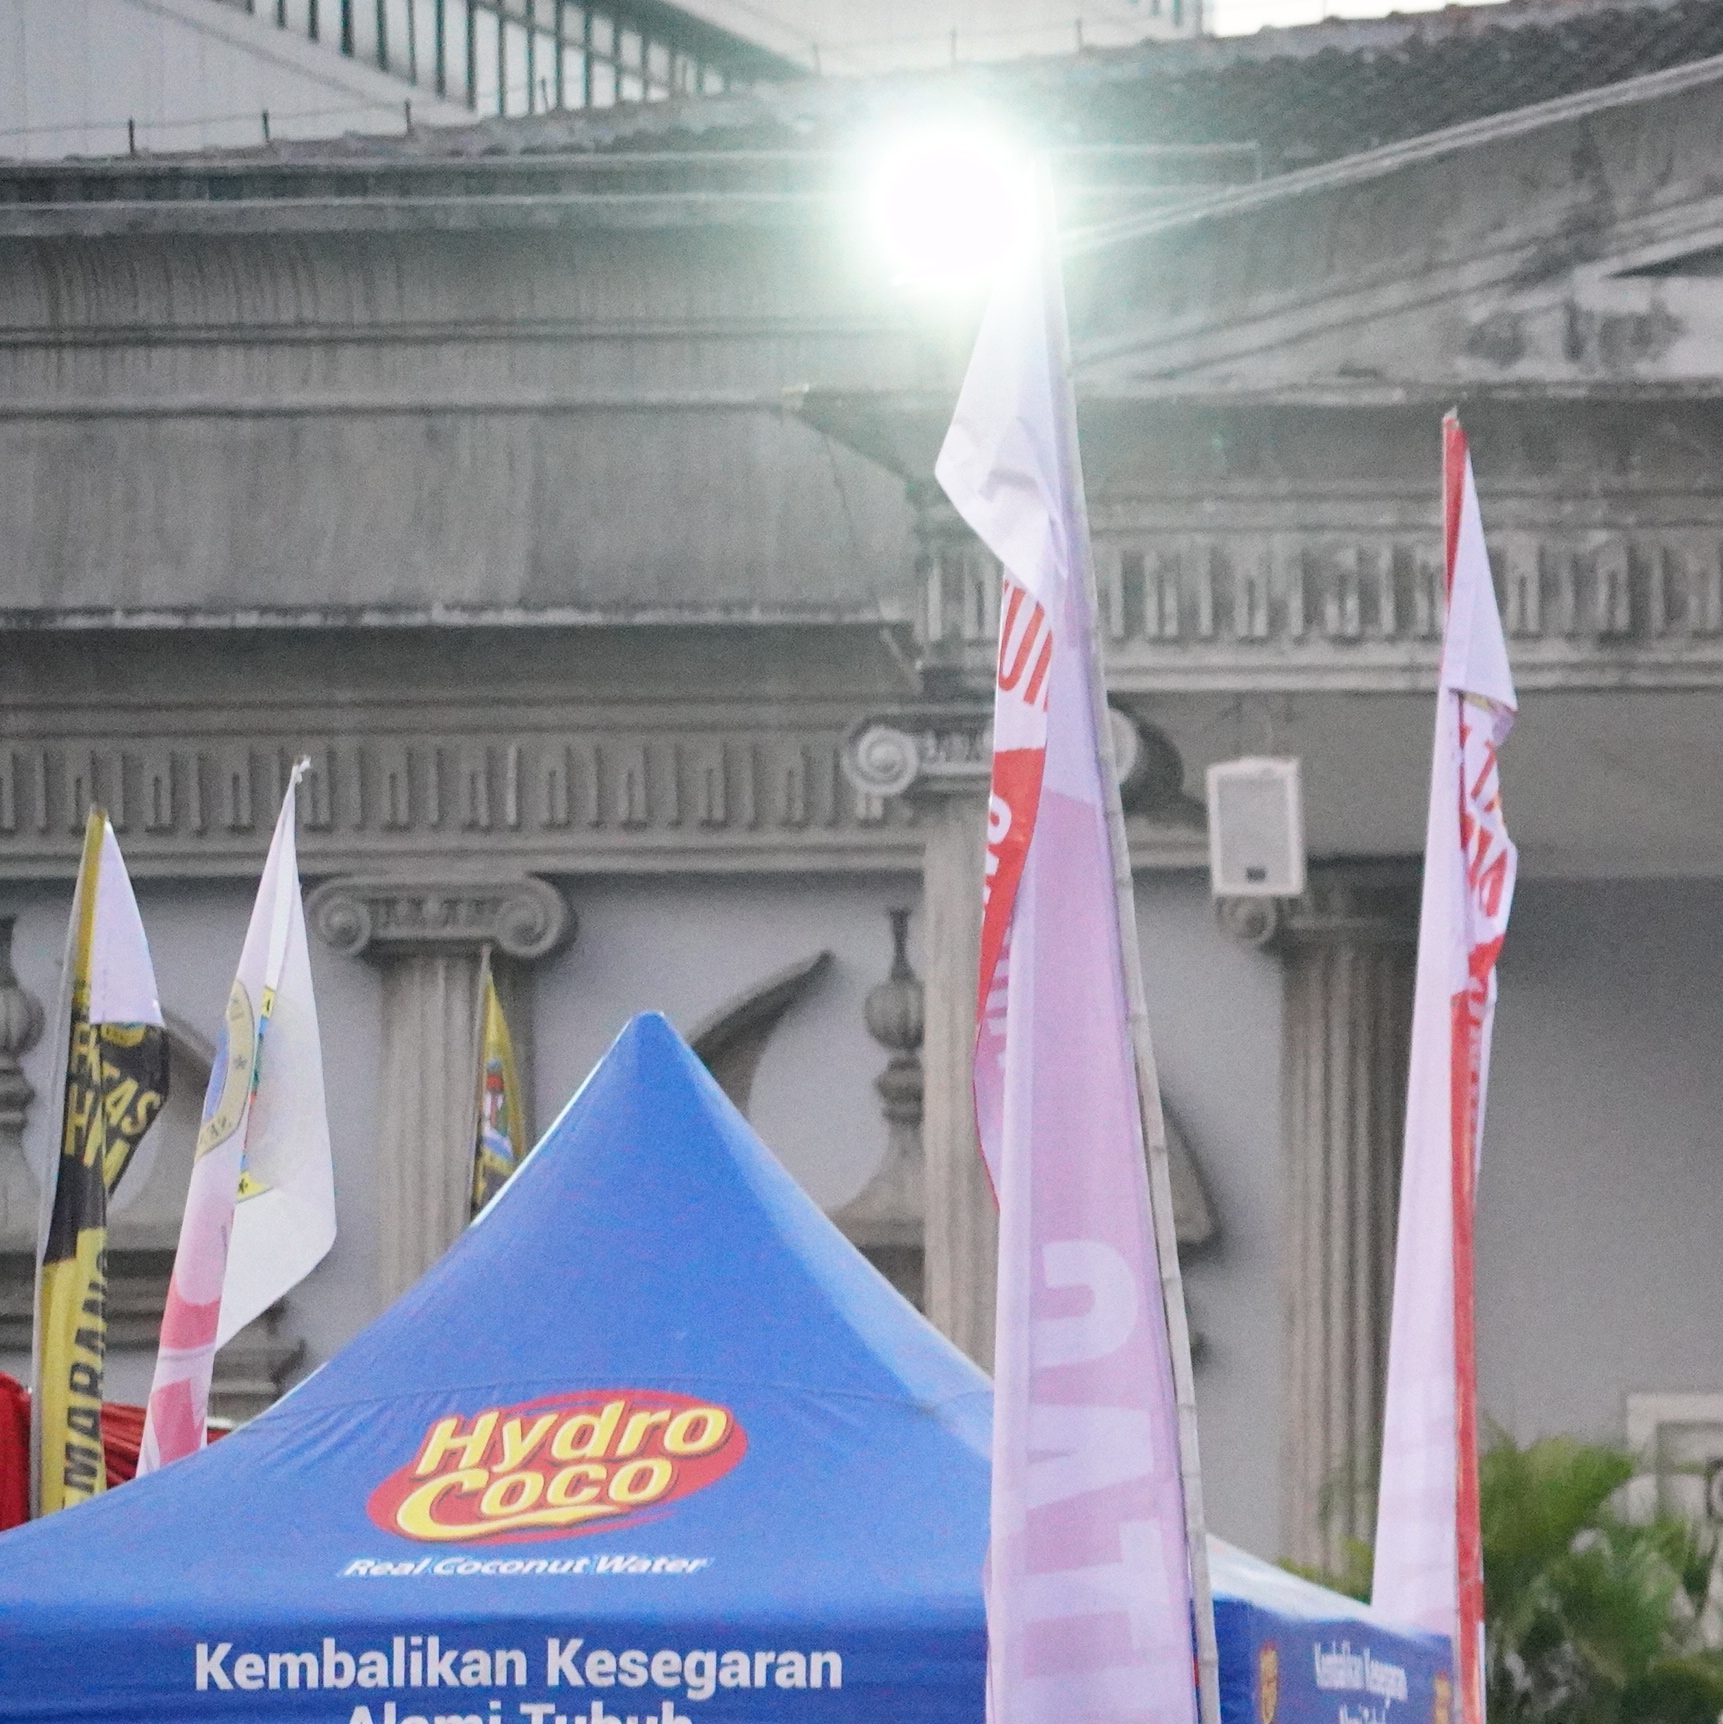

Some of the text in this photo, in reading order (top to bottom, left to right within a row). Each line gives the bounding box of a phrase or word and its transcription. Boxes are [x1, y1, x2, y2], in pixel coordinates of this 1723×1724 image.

[414, 1399, 727, 1476] Hydro
[395, 1457, 674, 1541] Coco
[343, 1554, 709, 1576] Real Coconut Water
[195, 1635, 843, 1701] Kembalikan Kesegaran
